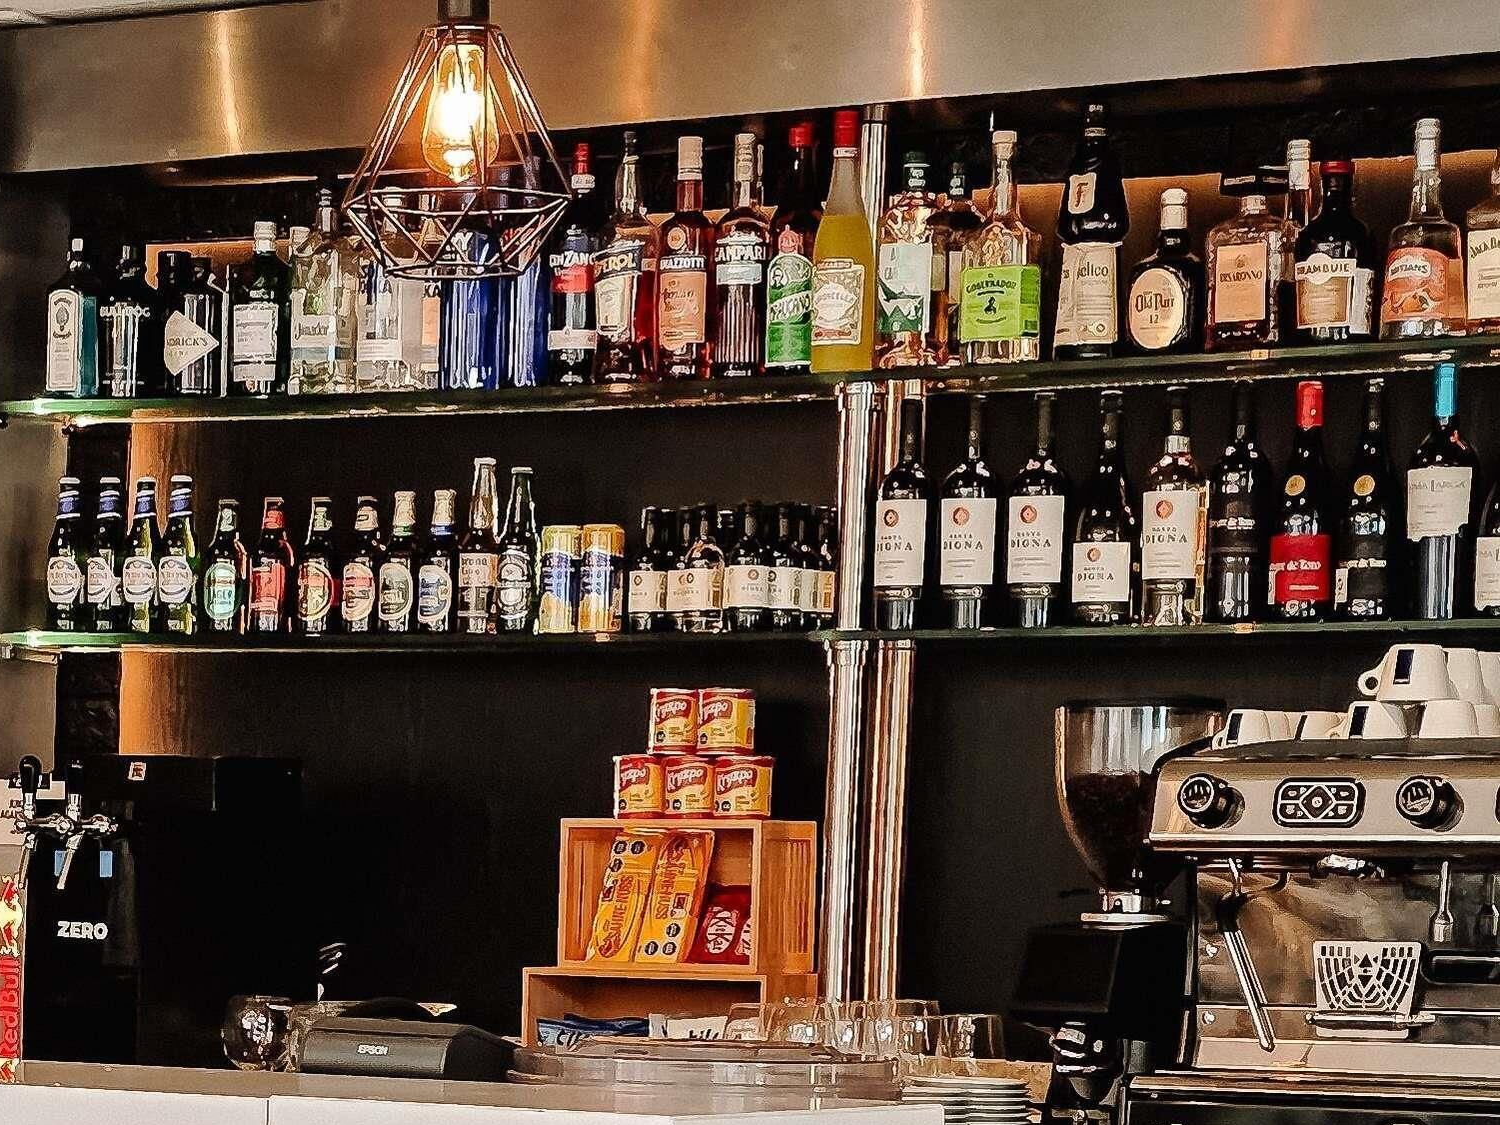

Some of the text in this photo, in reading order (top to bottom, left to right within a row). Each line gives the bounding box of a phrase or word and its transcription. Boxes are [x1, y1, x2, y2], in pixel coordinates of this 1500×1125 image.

[714, 245, 767, 263] CAMPARI
[1134, 293, 1153, 314] Old
[1148, 314, 1160, 324] 12
[57, 920, 109, 940] ZERO
[357, 1044, 389, 1056] EPSON
